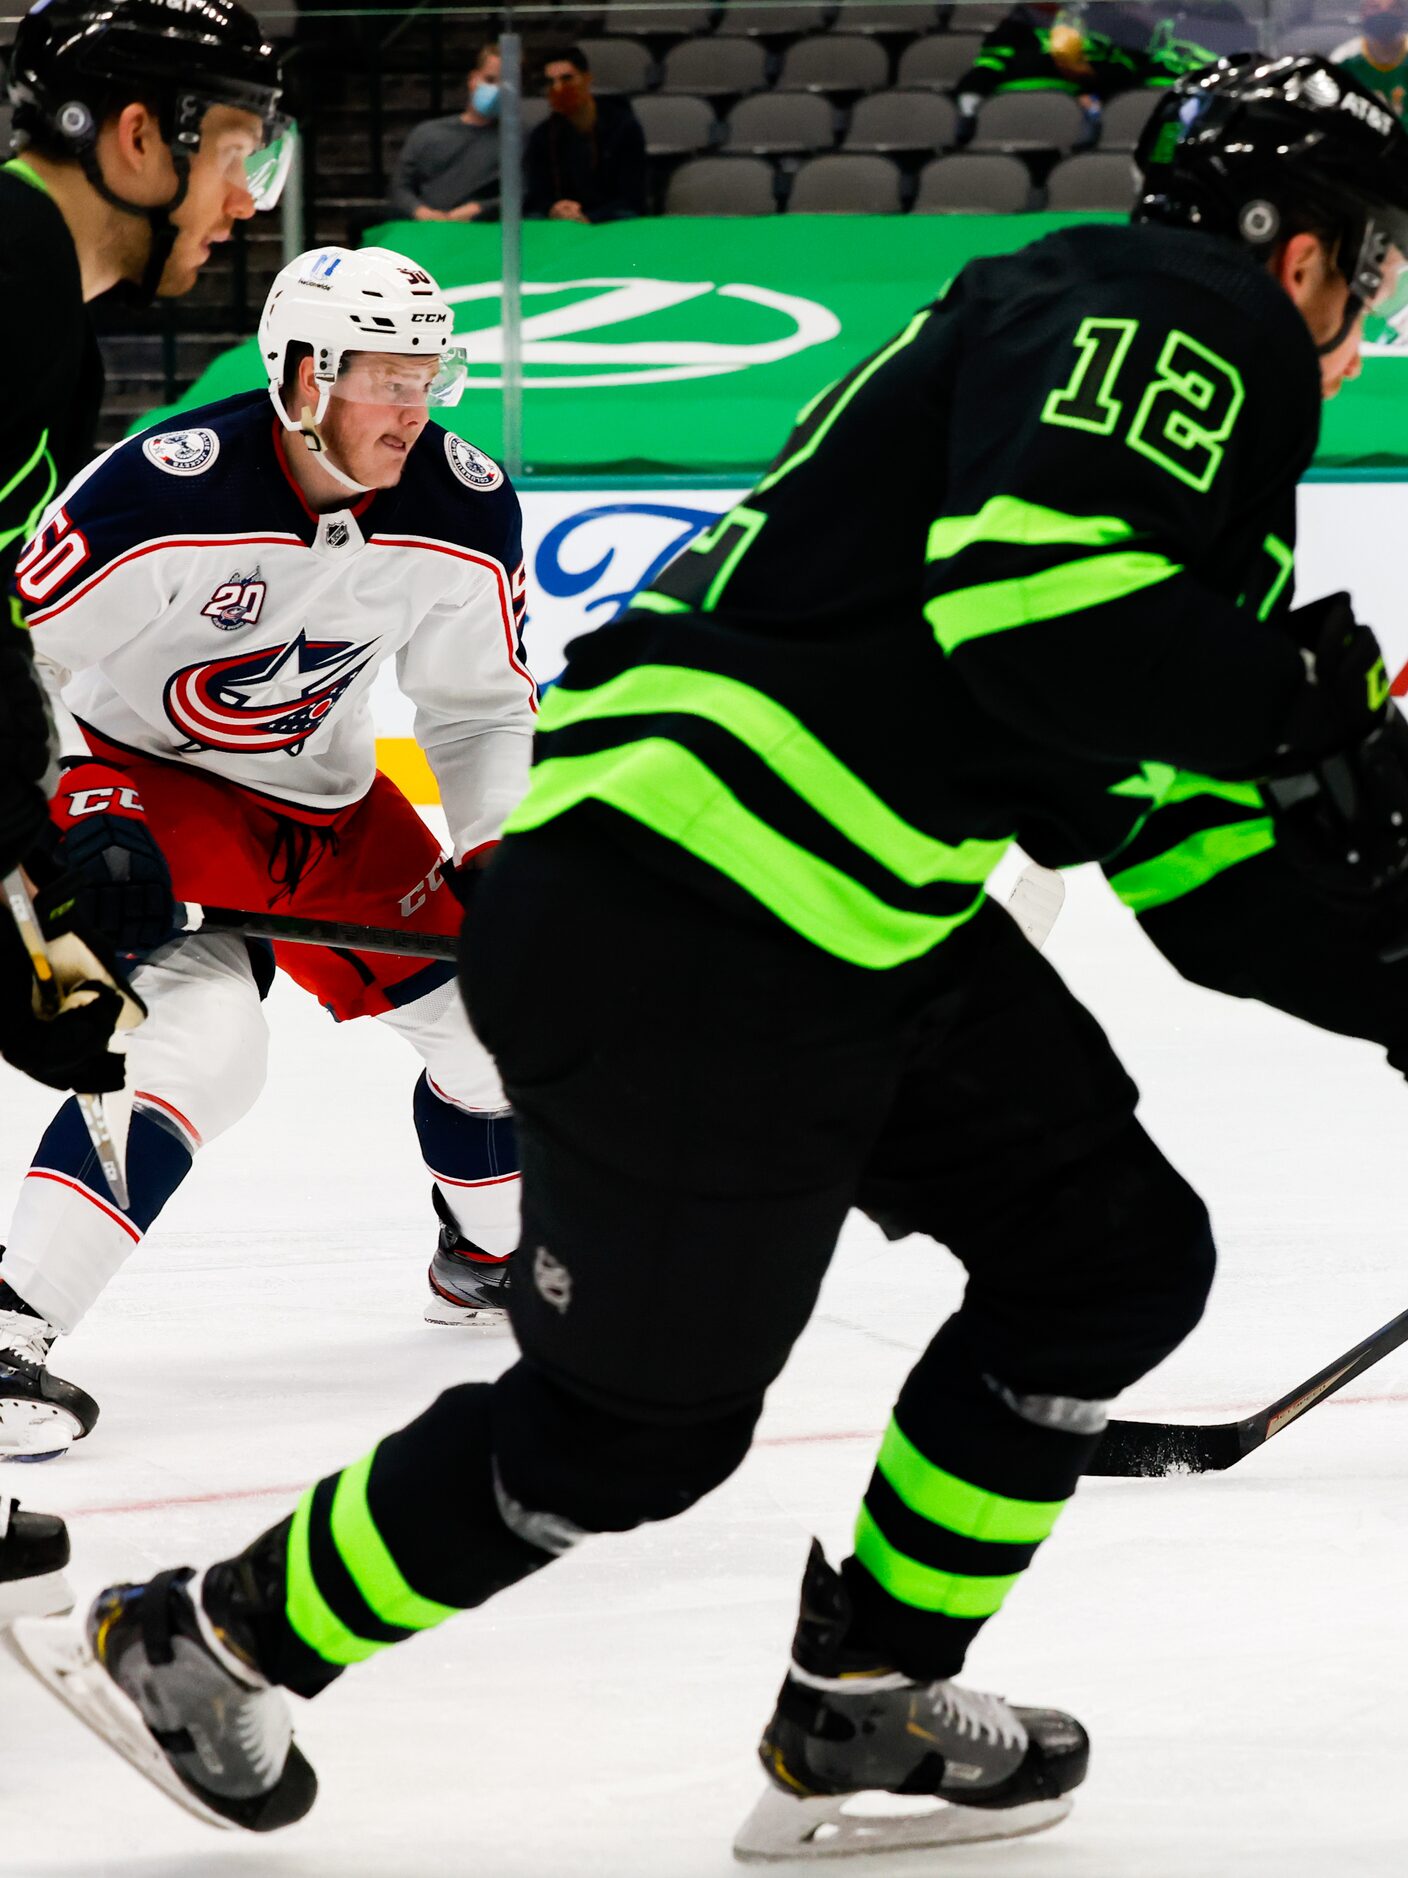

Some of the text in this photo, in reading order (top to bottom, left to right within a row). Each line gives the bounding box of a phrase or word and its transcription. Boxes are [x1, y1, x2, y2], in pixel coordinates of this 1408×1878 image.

[1341, 91, 1394, 137] AT&T
[411, 313, 447, 323] CCM
[1040, 316, 1245, 493] 12
[200, 581, 266, 625] 20
